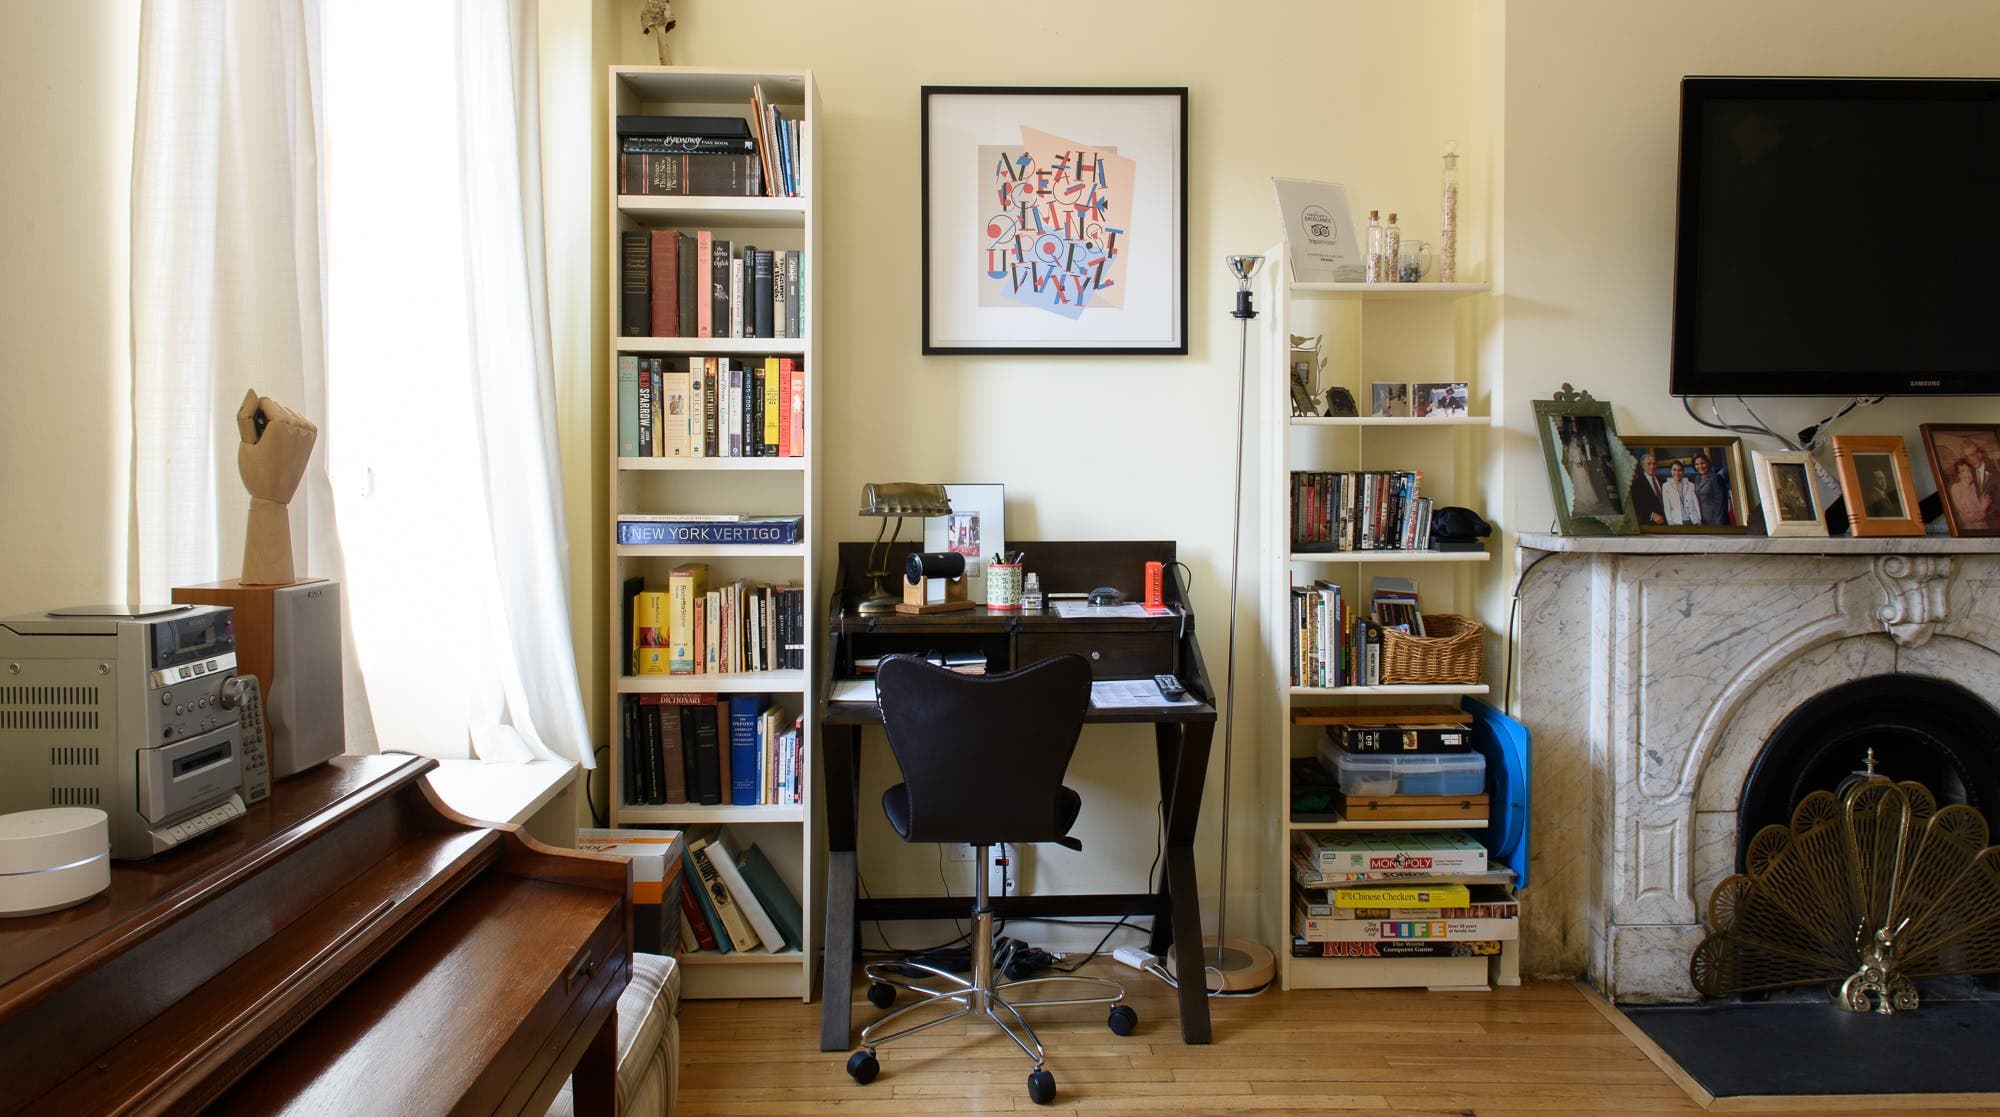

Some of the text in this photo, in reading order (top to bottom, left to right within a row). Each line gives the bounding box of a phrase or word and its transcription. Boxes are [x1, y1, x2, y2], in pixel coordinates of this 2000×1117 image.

[639, 371, 650, 427] RED SPARROW
[632, 527, 781, 541] NEW YORK VERTIGO
[660, 696, 701, 704] DICTIONARY
[1371, 858, 1431, 869] MONOPOLY
[1353, 892, 1415, 902] Chinese Checkers
[1383, 922, 1446, 937] LIFE
[1323, 941, 1380, 957] RISK
